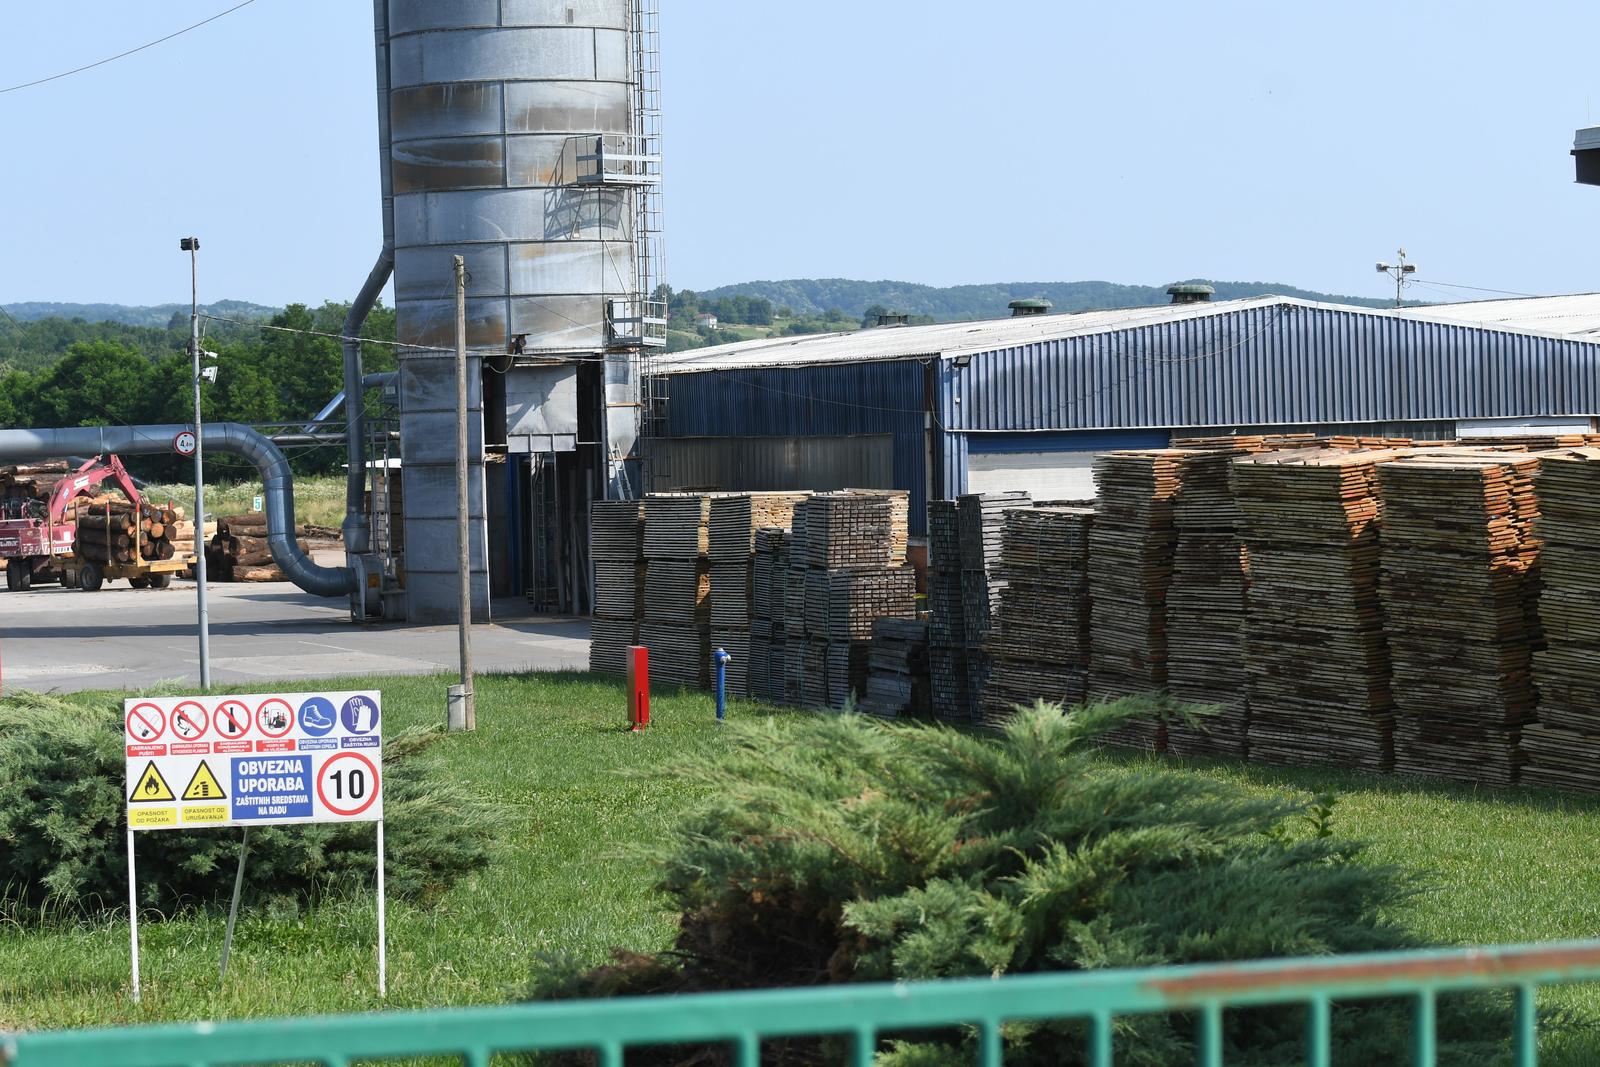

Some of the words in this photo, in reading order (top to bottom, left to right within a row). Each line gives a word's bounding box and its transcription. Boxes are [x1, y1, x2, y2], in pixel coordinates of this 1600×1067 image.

[254, 498, 261, 510] 5
[238, 759, 304, 775] OBVEZNA
[238, 777, 304, 793] UPORABA
[330, 769, 364, 799] 10
[236, 795, 271, 806] ZAŠTITNIH
[271, 794, 309, 804] SREDSTAVA
[258, 807, 268, 815] NA
[268, 806, 287, 815] RADU
